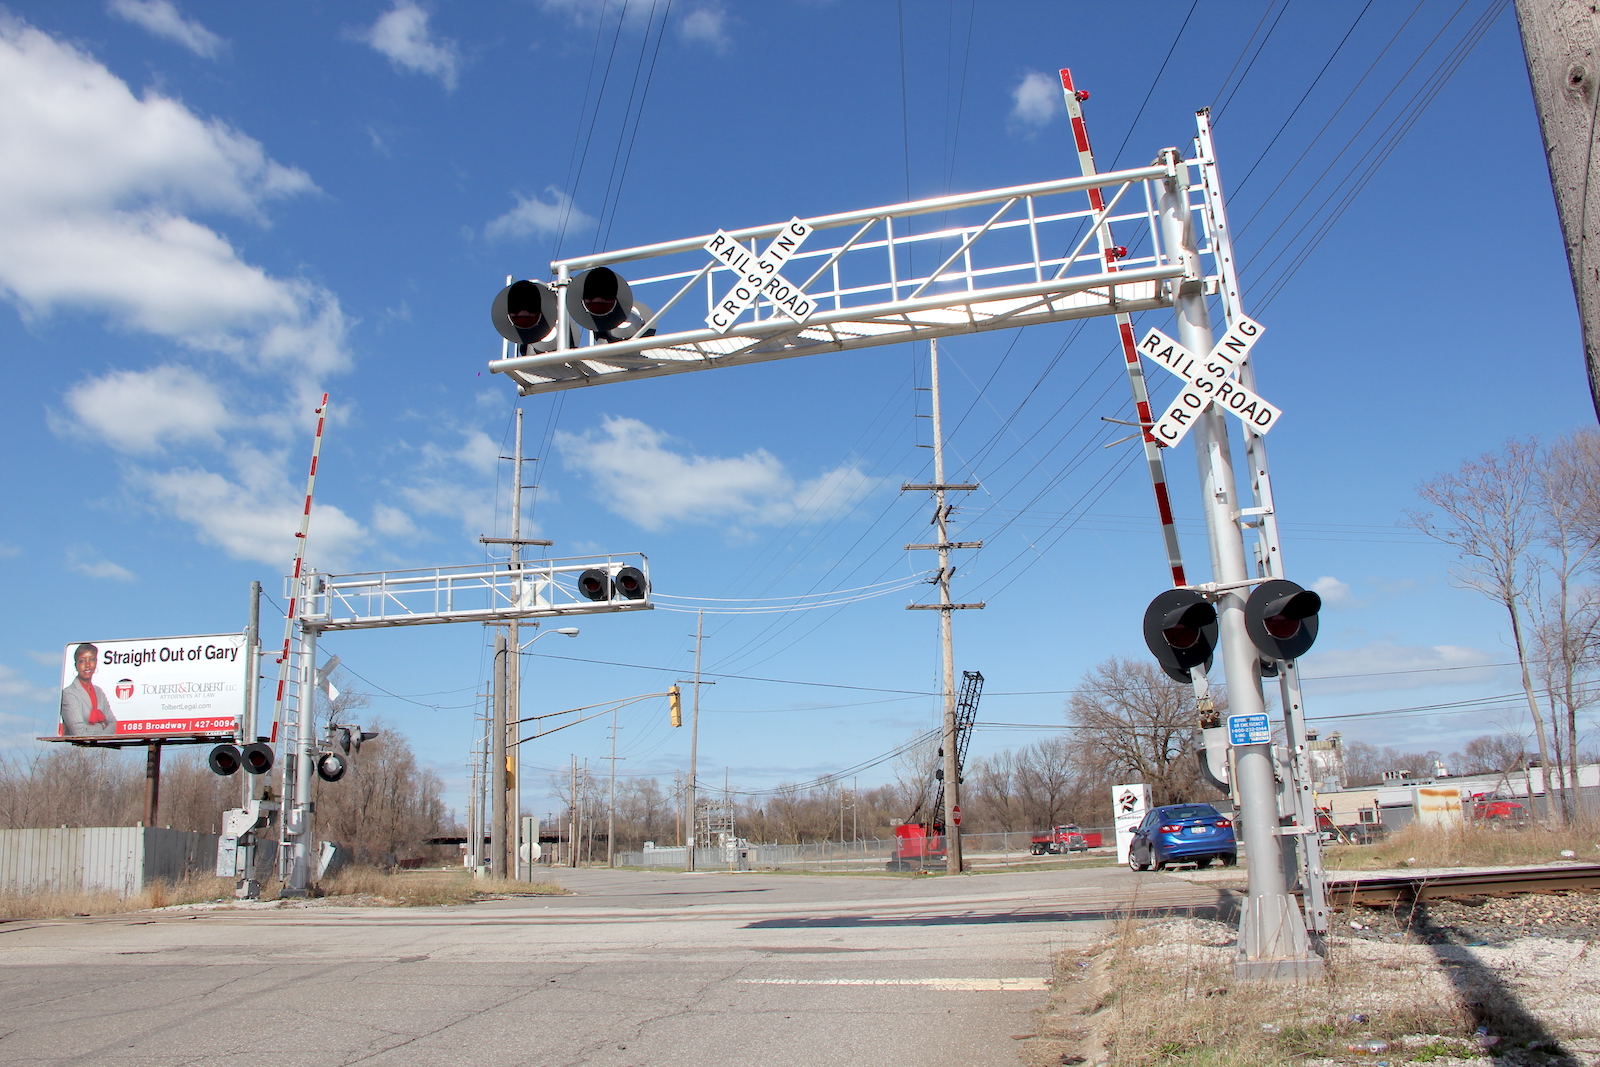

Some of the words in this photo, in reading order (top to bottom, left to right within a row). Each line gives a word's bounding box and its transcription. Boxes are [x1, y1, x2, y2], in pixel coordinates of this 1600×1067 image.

[709, 235, 750, 274] RAIL
[765, 277, 809, 316] ROAD
[712, 223, 806, 327] CROSSING
[1143, 333, 1194, 379] RAIL
[1215, 381, 1272, 427] ROAD
[1159, 321, 1257, 440] CROSSING
[103, 648, 156, 667] Straight
[159, 646, 184, 662] Out
[187, 645, 202, 661] of
[204, 644, 239, 662] Gary
[159, 692, 193, 700] ATTORNEYS
[161, 703, 212, 711] TolbertLegal.com
[122, 722, 143, 731] 1085
[145, 721, 187, 731] Broadway
[194, 719, 235, 729] 427-0094
